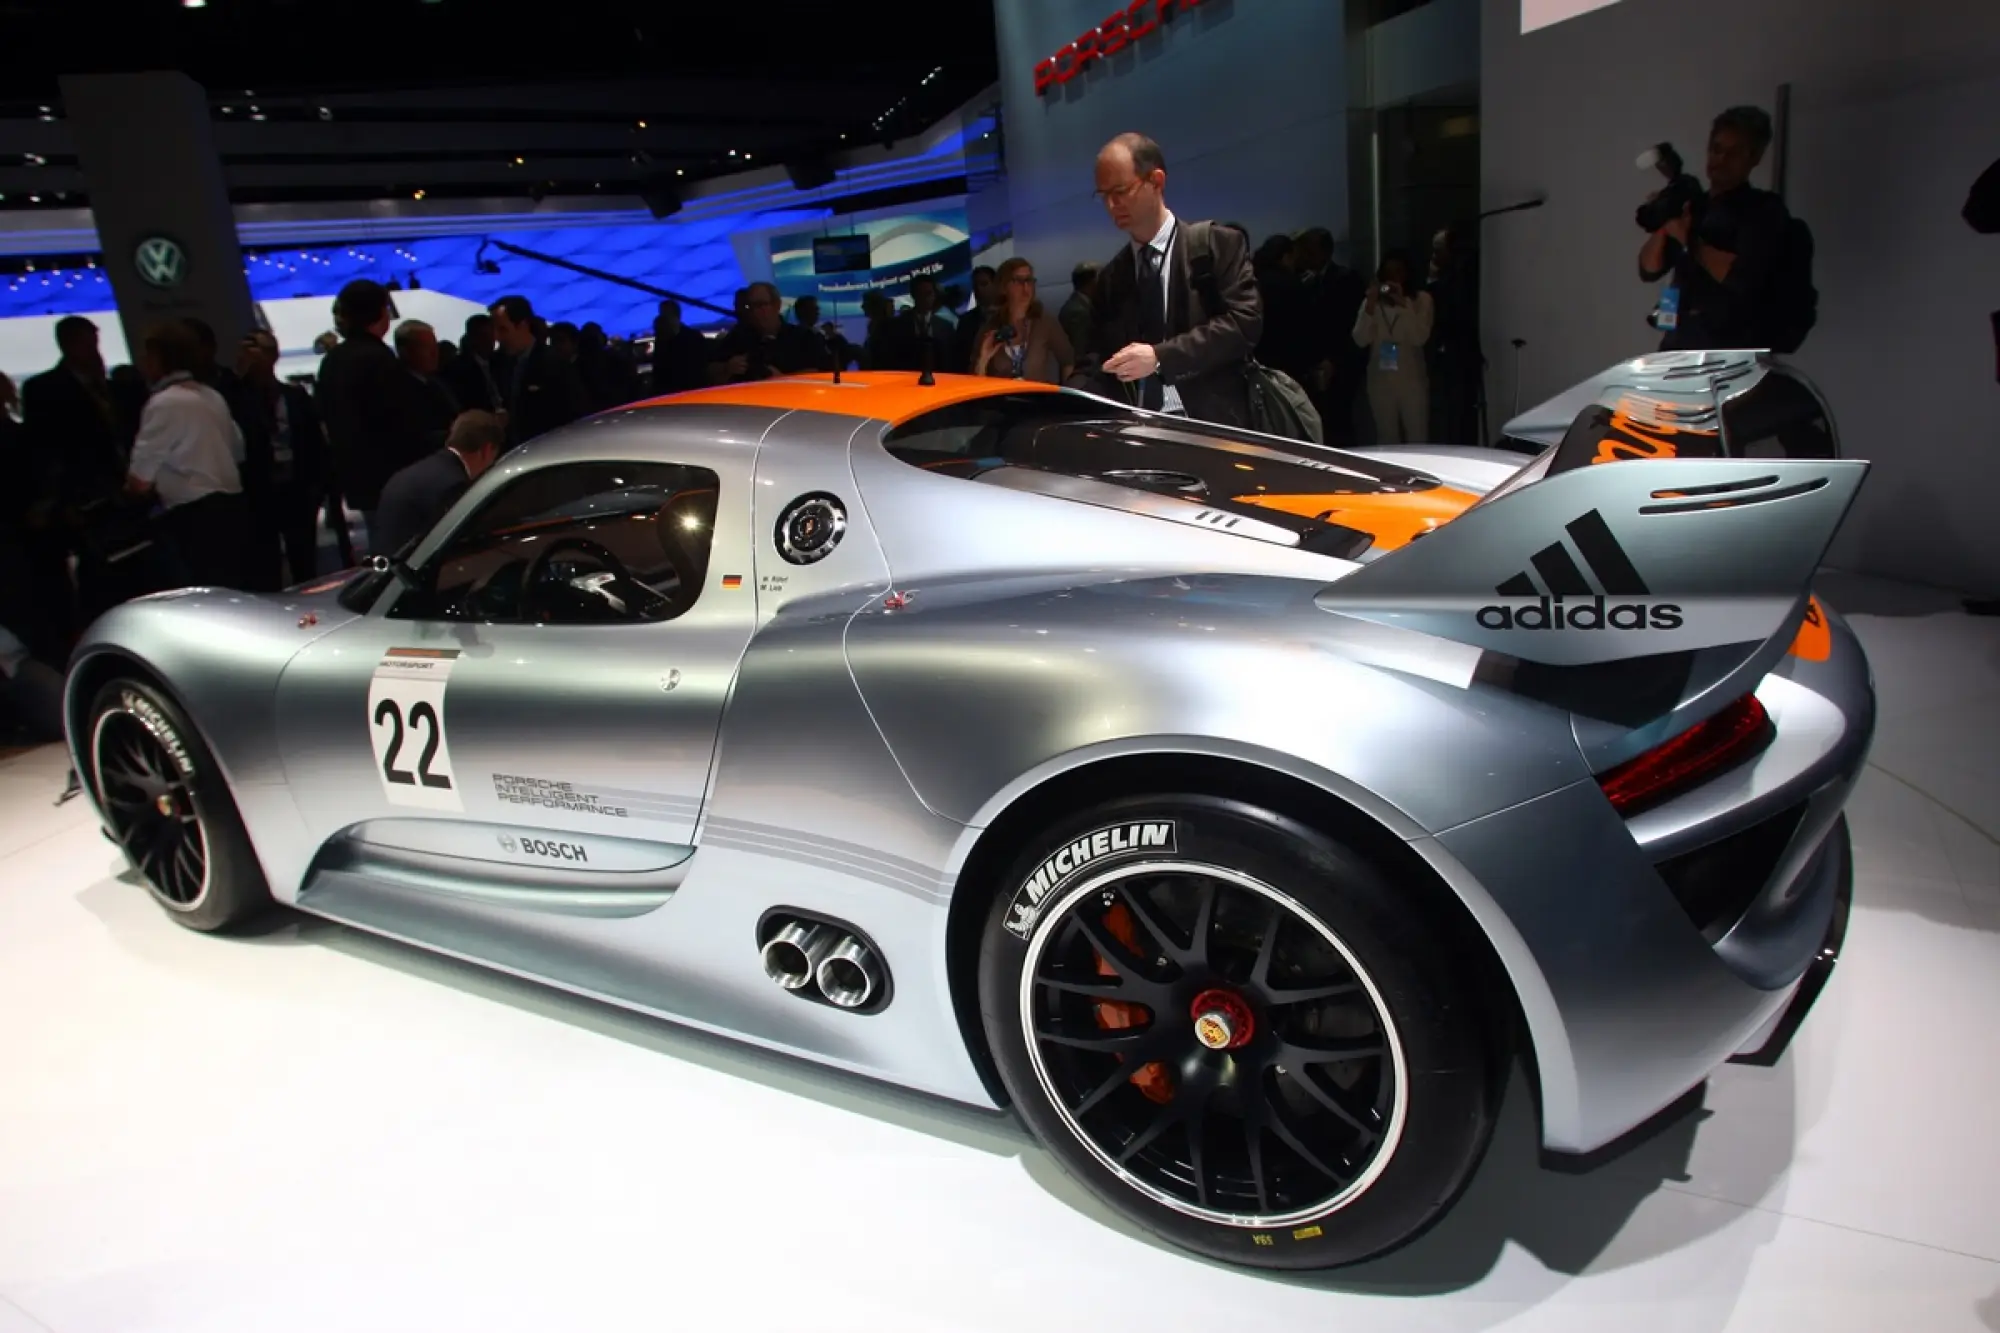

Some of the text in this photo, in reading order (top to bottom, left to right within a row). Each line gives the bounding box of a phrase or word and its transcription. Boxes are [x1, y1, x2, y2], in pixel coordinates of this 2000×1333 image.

[1475, 595, 1684, 630] adidas
[134, 697, 194, 773] MICHELIN
[374, 698, 452, 790] 22
[492, 773, 573, 792] PORSCHE
[494, 784, 599, 804] INTELLIGENT
[497, 792, 629, 817] PERFORMANCE
[519, 838, 588, 862] BOSCH
[1025, 824, 1170, 905] MICHELIN
